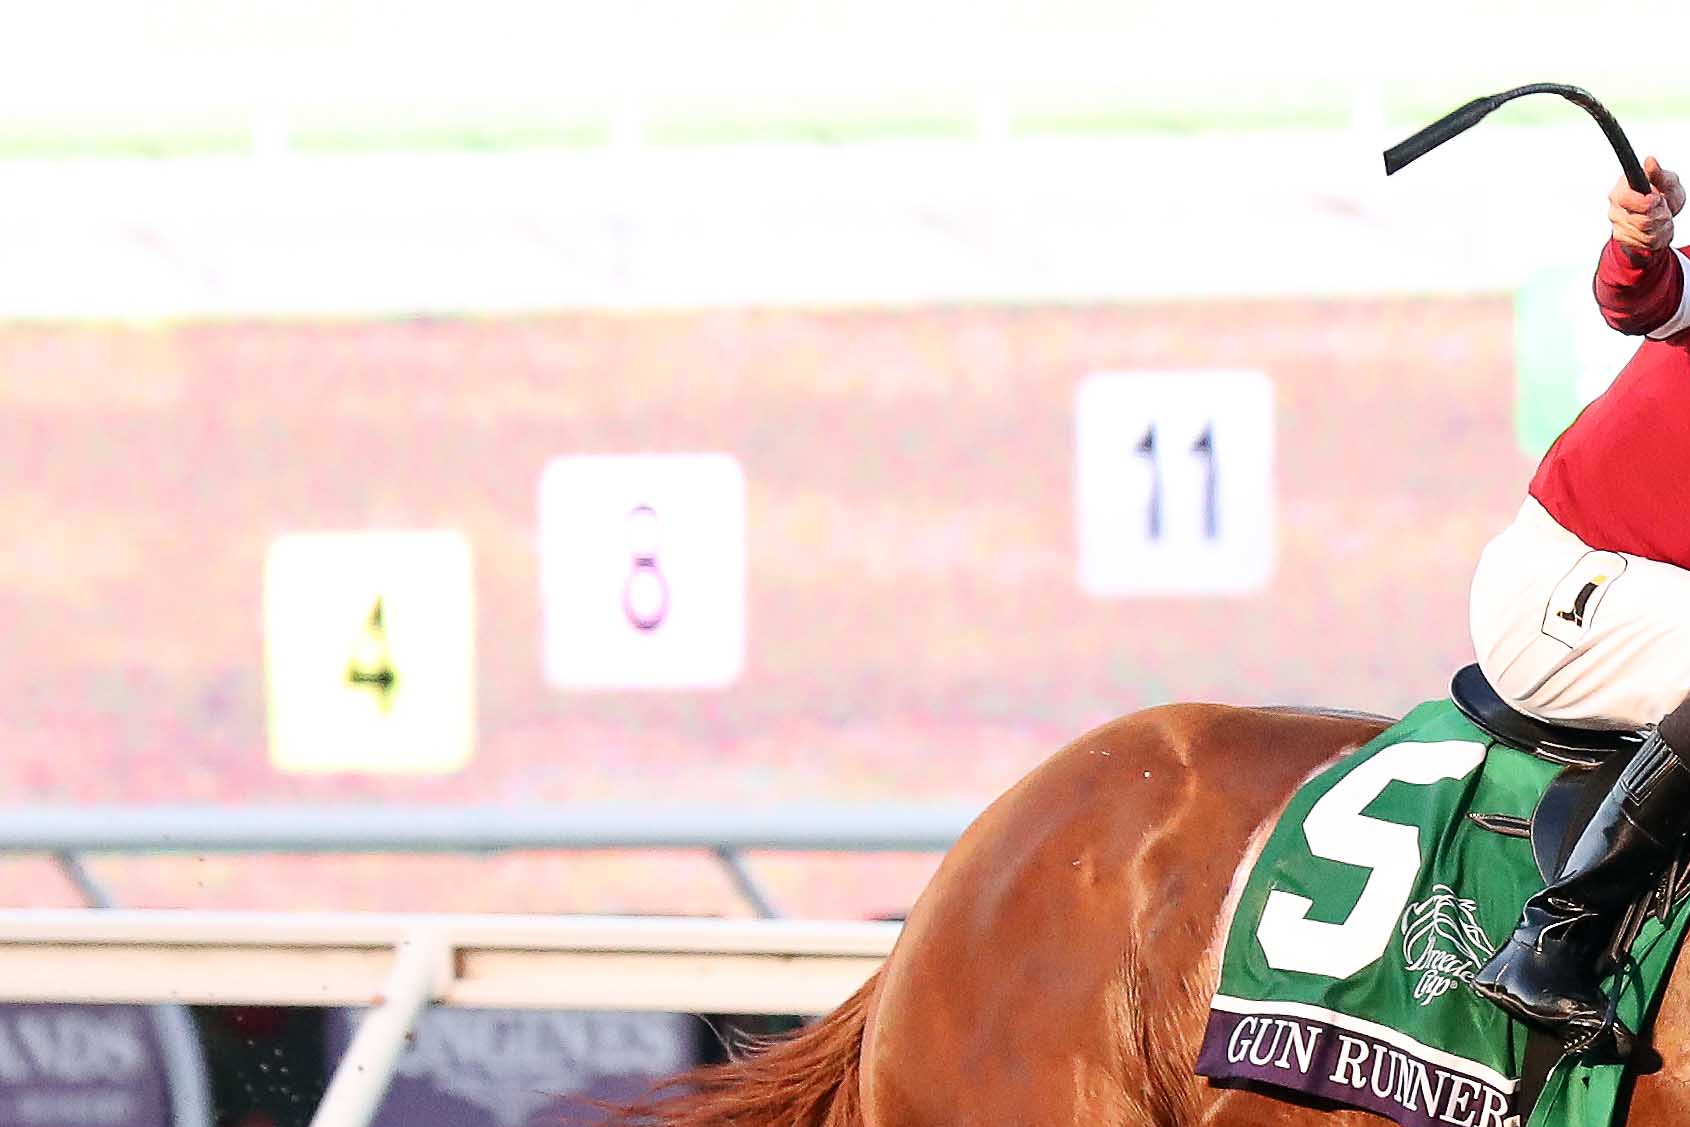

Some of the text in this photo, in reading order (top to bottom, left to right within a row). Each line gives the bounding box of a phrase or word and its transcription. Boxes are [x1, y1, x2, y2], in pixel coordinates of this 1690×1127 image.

[1134, 420, 1216, 543] 11
[344, 595, 396, 714] 4
[1257, 740, 1487, 979] 5
[1227, 1016, 1323, 1074] GUN
